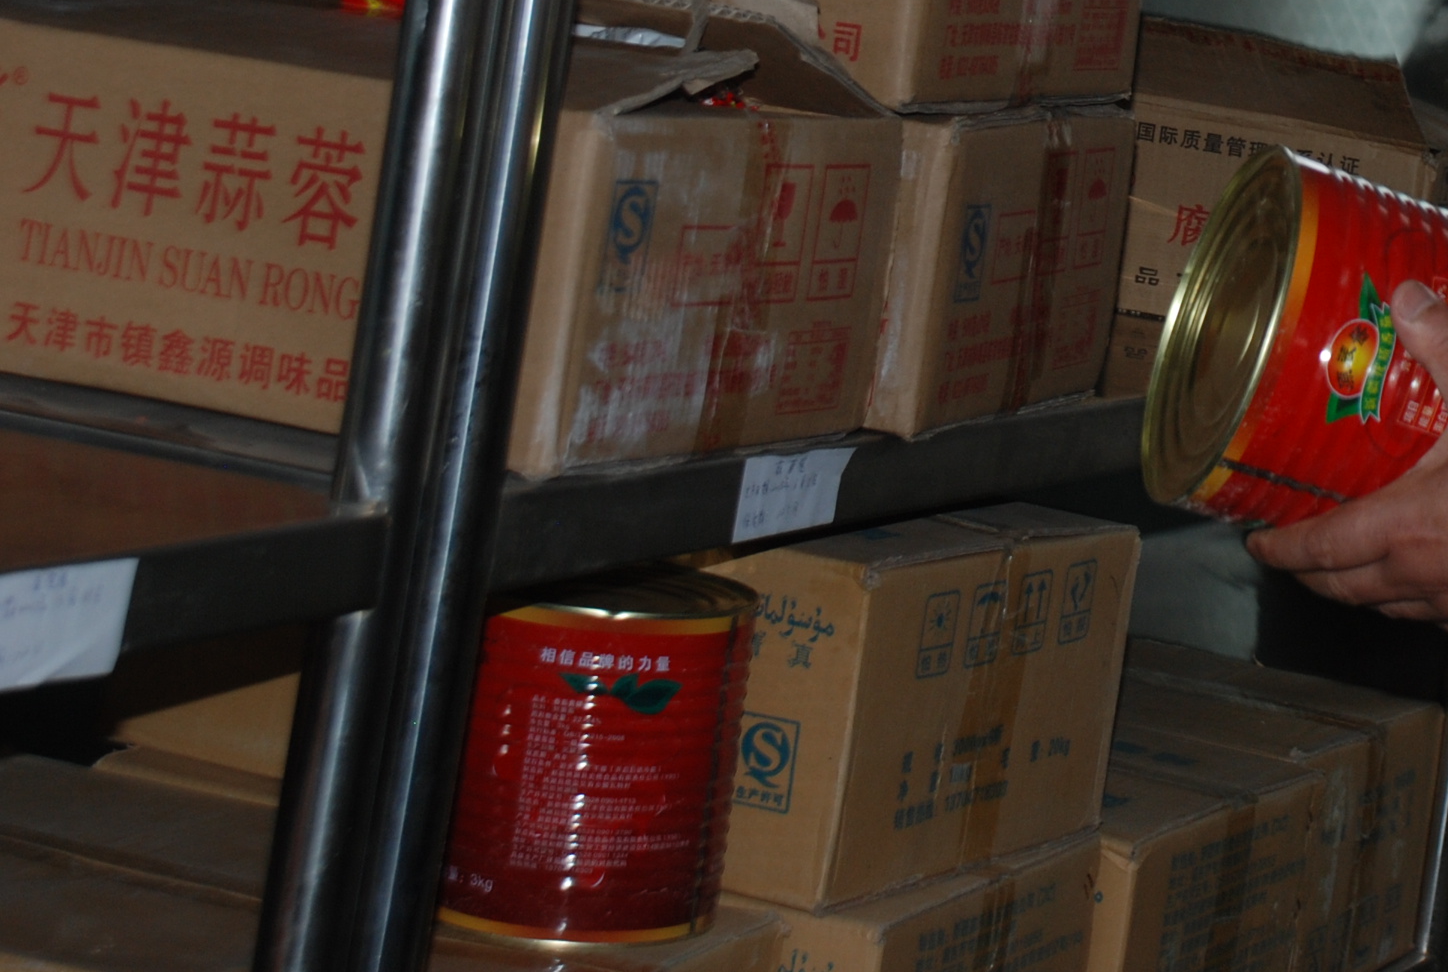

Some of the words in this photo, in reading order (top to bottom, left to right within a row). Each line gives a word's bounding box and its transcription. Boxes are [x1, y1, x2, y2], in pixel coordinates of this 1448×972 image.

[22, 91, 368, 252] 天津蒜蓉
[19, 217, 156, 284] TIANJIN
[158, 243, 257, 301] SUAN
[258, 265, 362, 321] RONG
[5, 299, 350, 404] 天津市镇鑫源调味品
[540, 645, 672, 673] 相信品牌的力量
